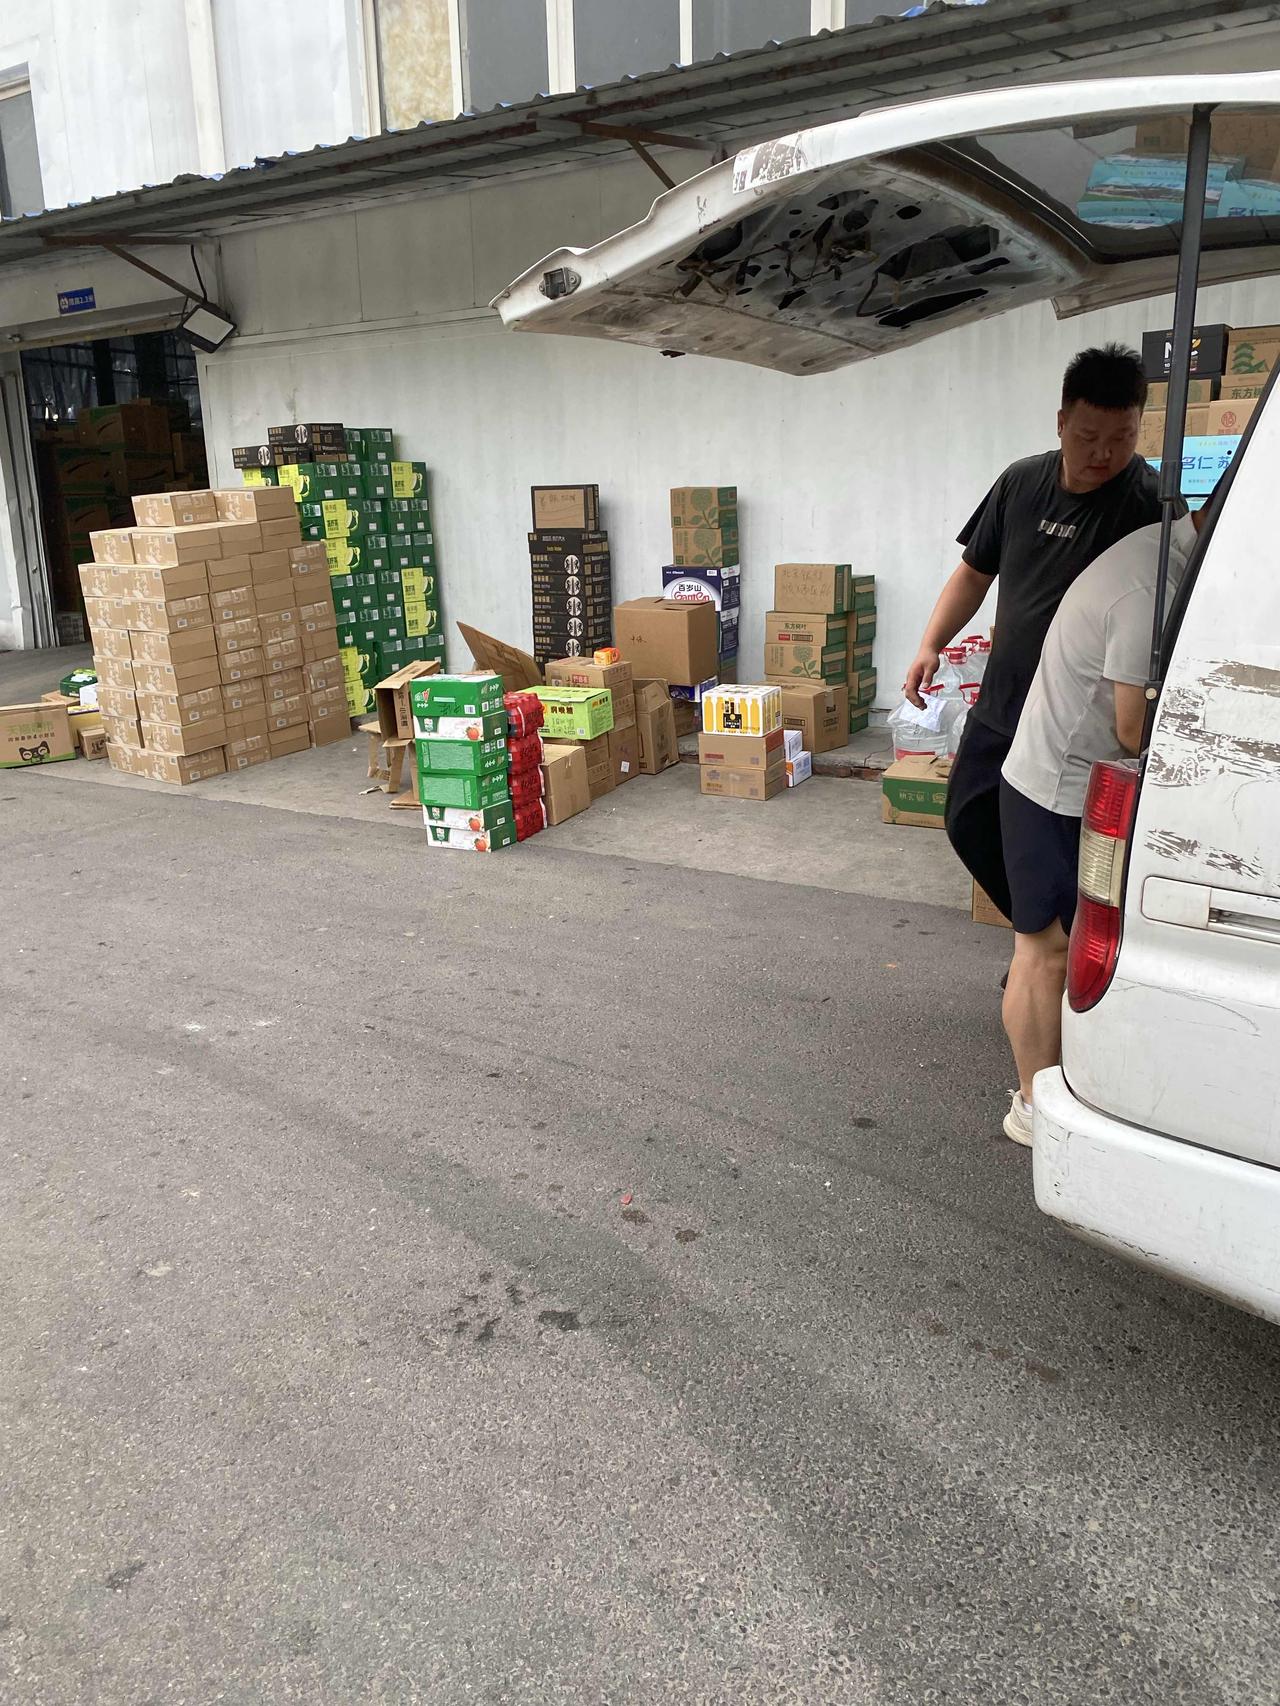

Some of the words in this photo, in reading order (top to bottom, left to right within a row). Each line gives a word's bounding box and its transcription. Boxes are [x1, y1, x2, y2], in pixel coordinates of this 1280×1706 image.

[678, 583, 702, 592] 百岁山
[784, 622, 807, 630] 东方树叶
